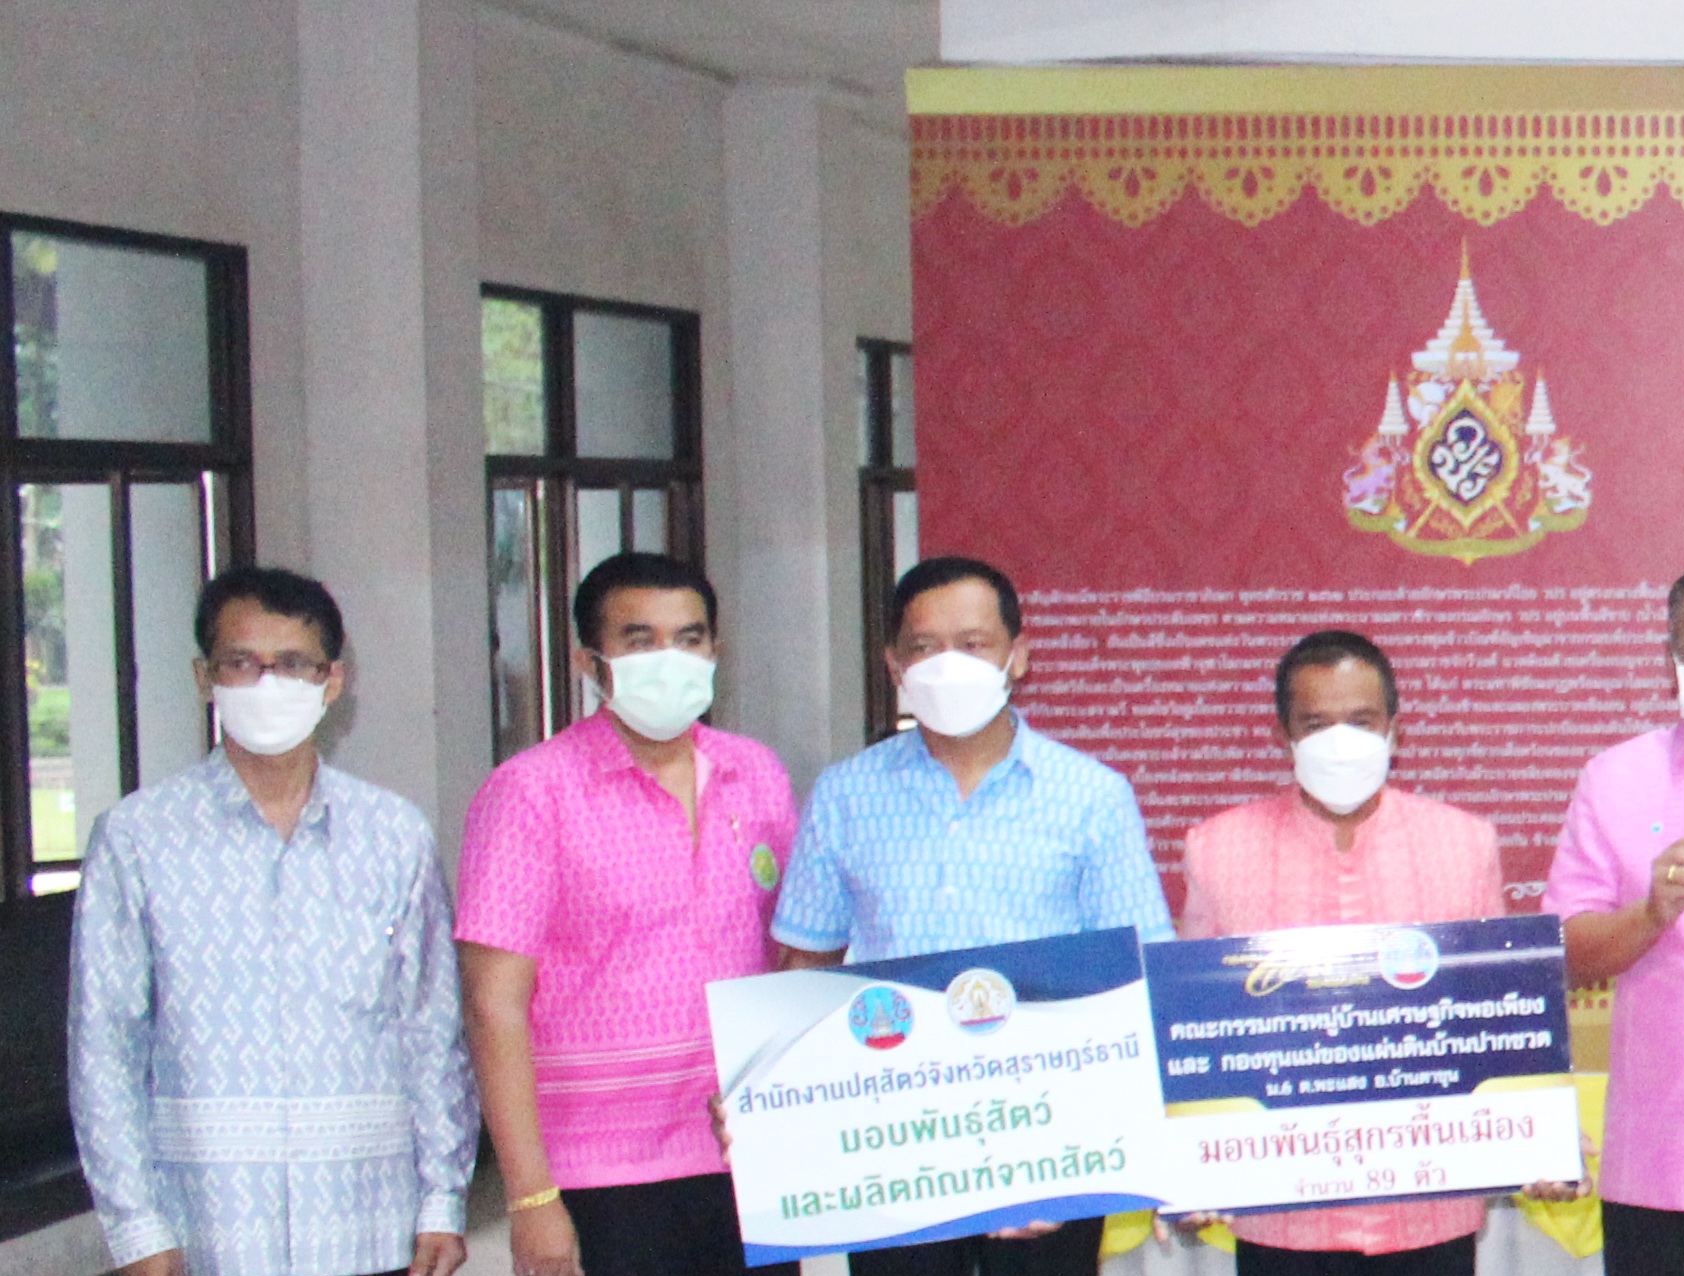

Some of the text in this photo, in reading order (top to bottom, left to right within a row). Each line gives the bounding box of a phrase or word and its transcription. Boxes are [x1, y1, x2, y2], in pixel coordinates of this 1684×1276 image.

[737, 1029, 1140, 1115] สำนักงานปศุสัตว์จังหวัดสุราษฎร์ธานี
[1167, 1055, 1211, 1076] และ
[839, 1091, 1053, 1155] มอบพันธุ์สัตว์
[1199, 1103, 1534, 1167] มอบพันธุ์สุกรพื้นเมือง
[780, 1136, 1127, 1220] และผลิตภัณฑ์จากสัตว์
[1294, 1161, 1447, 1198] จำนวน 89 ตัว
